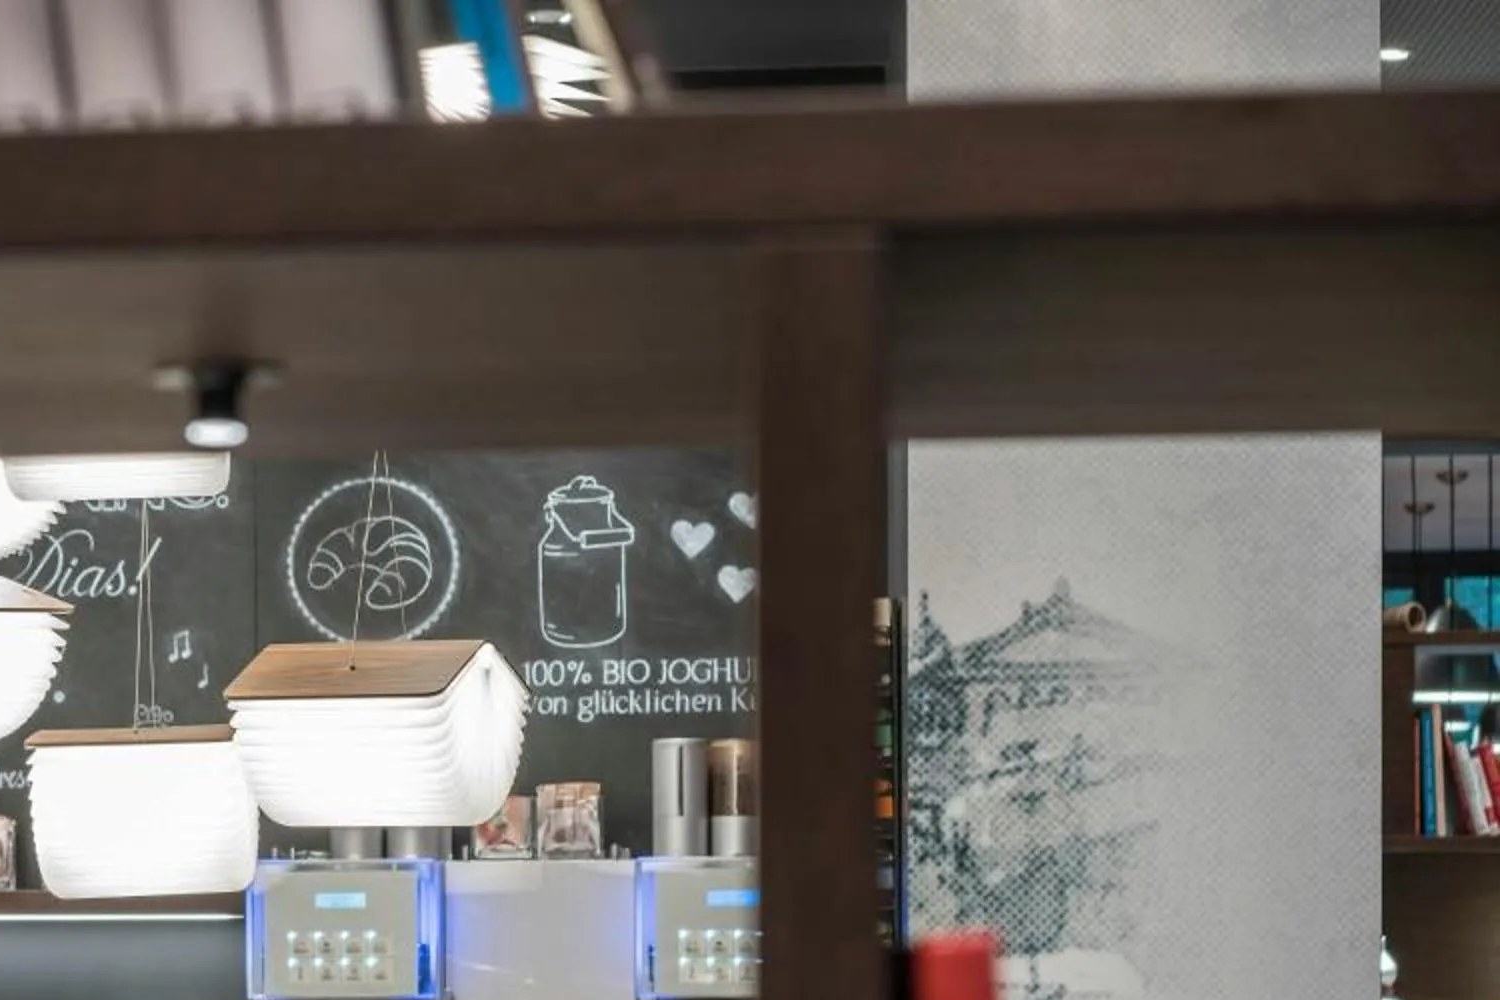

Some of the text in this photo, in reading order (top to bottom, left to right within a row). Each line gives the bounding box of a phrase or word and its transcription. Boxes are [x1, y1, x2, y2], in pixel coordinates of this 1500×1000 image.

[521, 655, 757, 687] 100% BIO JOGHU
[532, 695, 567, 715] on
[576, 687, 722, 723] glücklichen
